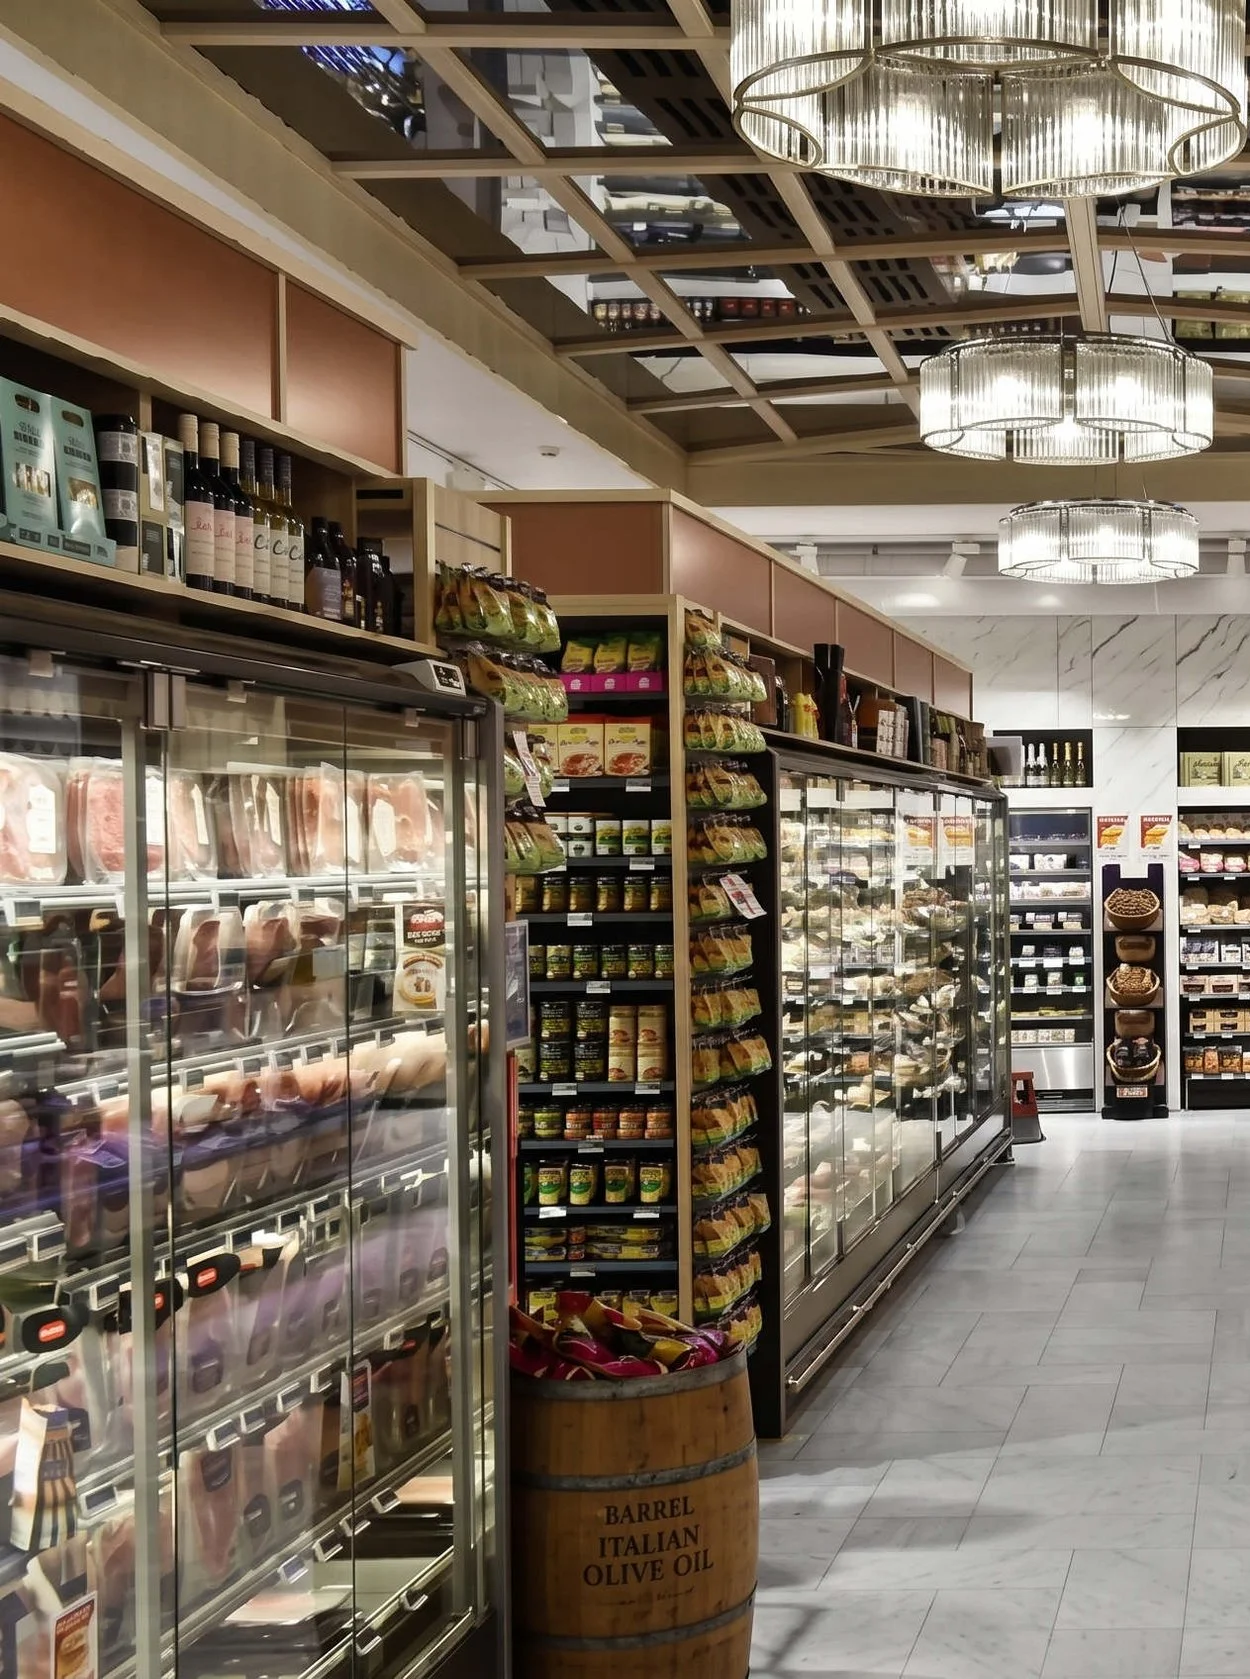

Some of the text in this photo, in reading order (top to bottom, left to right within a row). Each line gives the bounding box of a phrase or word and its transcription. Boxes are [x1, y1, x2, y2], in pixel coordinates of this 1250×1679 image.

[604, 1496, 695, 1525] BARREL
[599, 1524, 700, 1558] ITALIAN
[583, 1549, 714, 1586] OLIVE OIL
